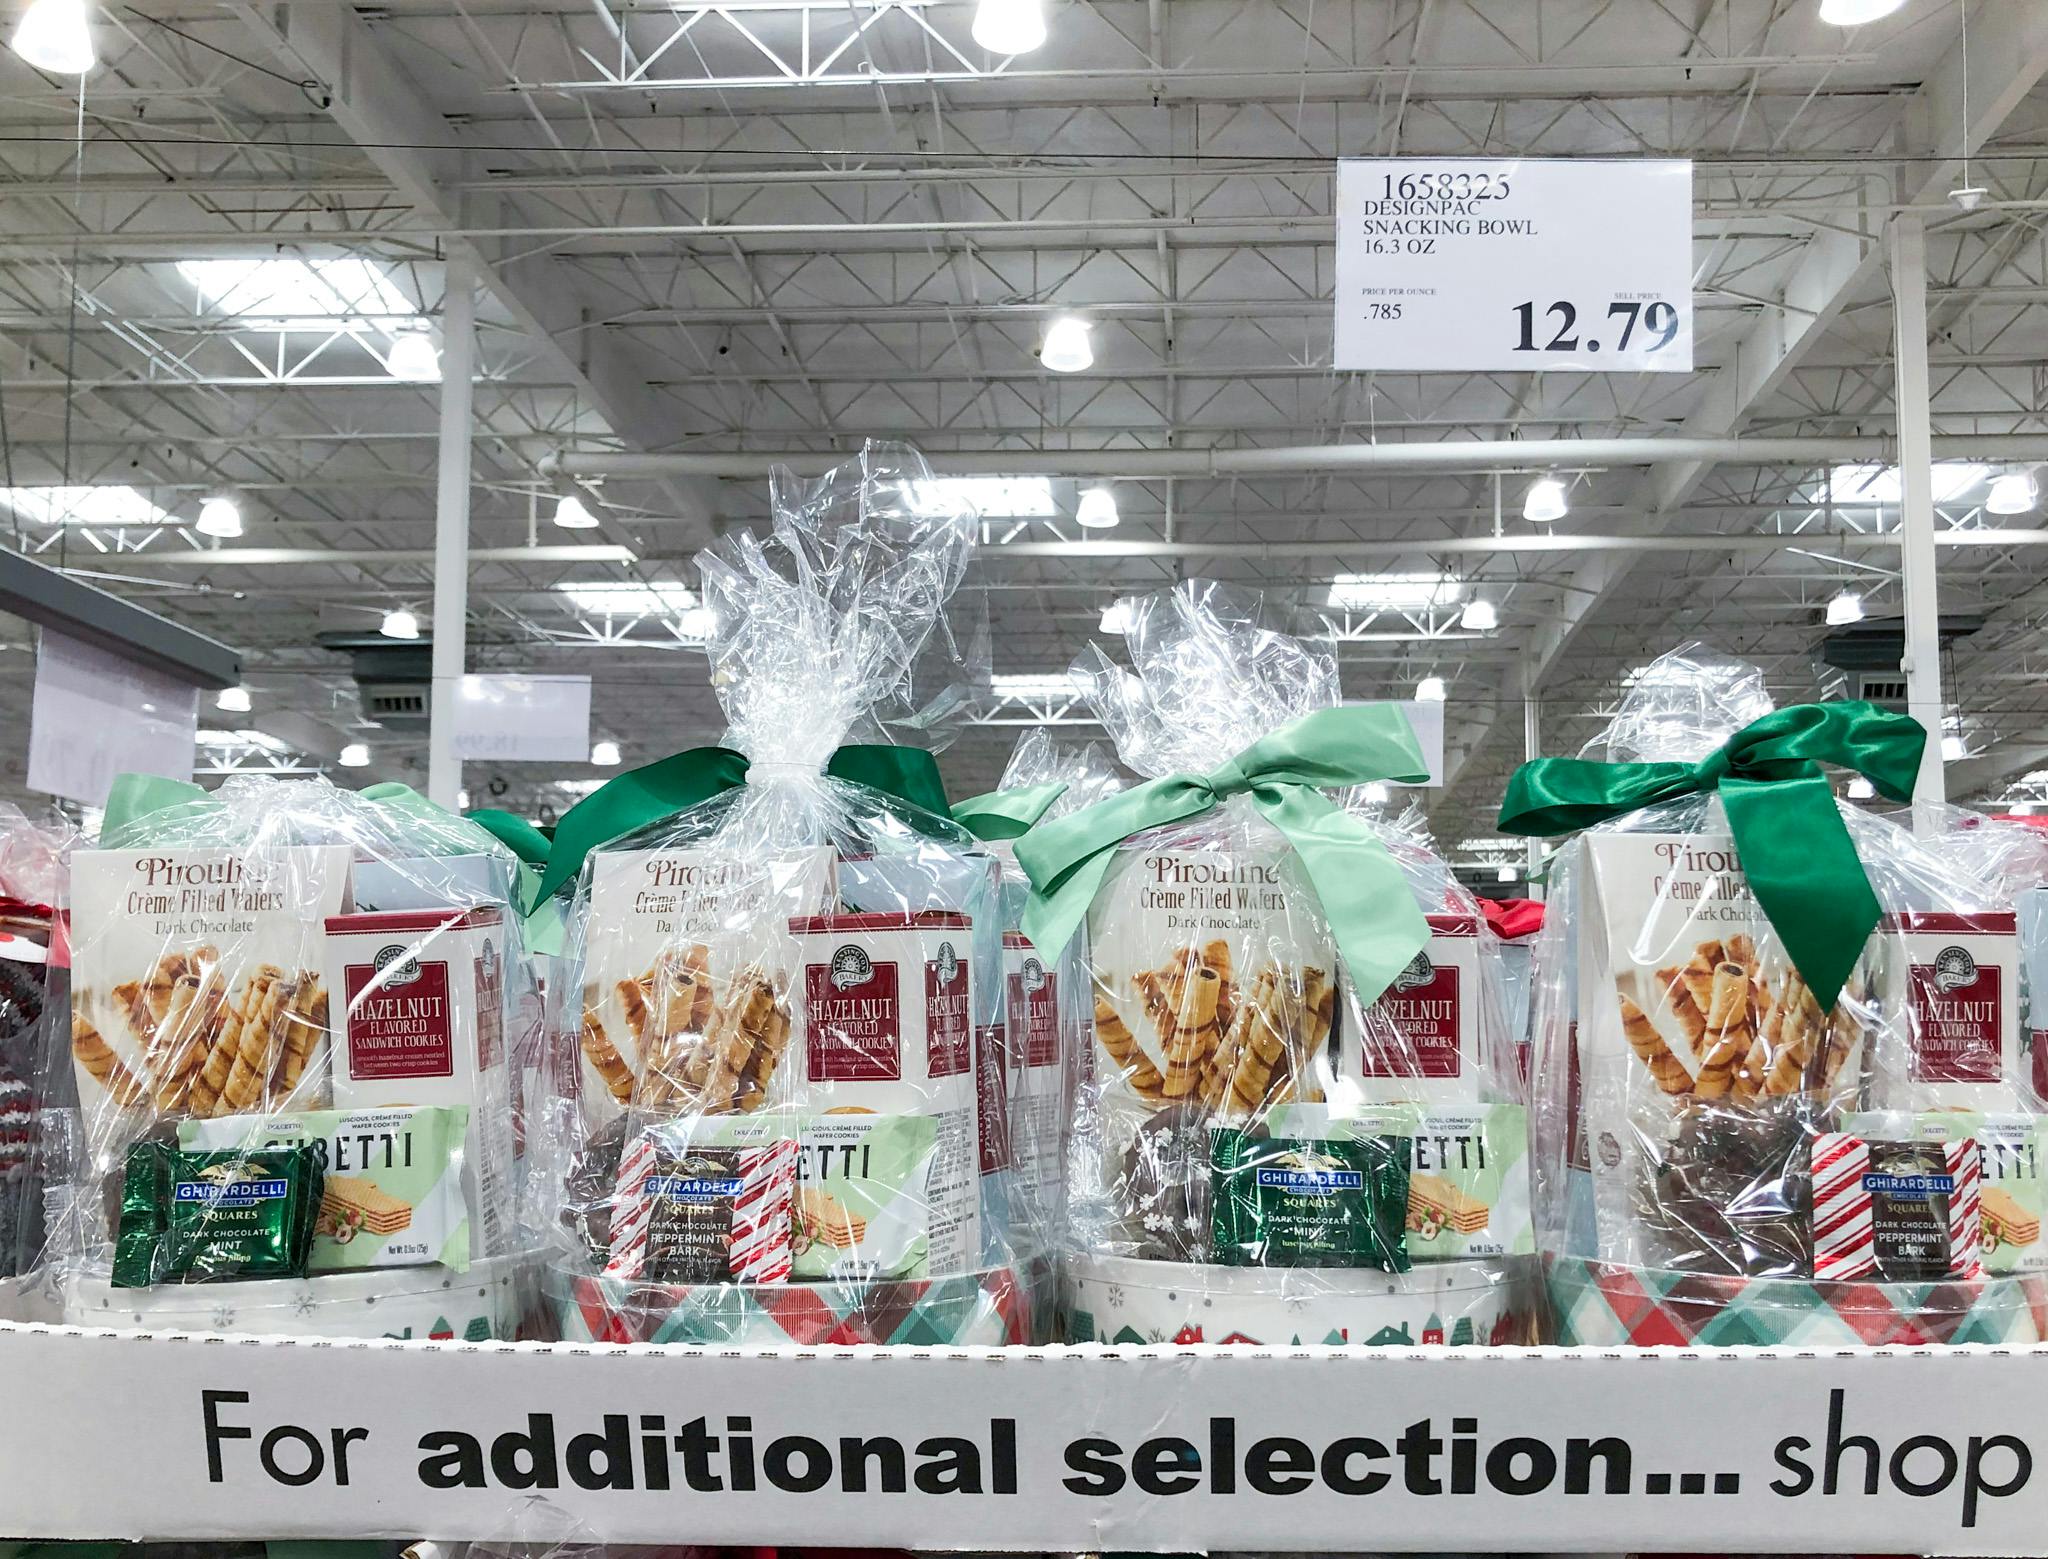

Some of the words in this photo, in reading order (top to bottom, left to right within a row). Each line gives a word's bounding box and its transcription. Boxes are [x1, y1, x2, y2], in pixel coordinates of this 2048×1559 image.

[1382, 173, 1511, 200] 1658325
[1363, 200, 1482, 216] DESIGNPAC
[1363, 219, 1471, 236] SNACKING
[1478, 219, 1538, 236] BOWL
[1363, 238, 1400, 254] 16.3
[1407, 238, 1436, 254] OZ
[1362, 287, 1386, 295] PRICE
[1388, 287, 1405, 295] PER
[1406, 287, 1437, 295] OUNCE
[1614, 292, 1635, 300] SELL
[1637, 292, 1662, 300] PRICE
[1363, 303, 1402, 320] .785
[1511, 300, 1680, 353] 12.79
[1654, 842, 1744, 872] Pirou
[135, 857, 279, 886] Pirouli
[1706, 876, 1750, 901] illed
[1141, 887, 1185, 909] Crème
[1191, 887, 1232, 909] Filled
[155, 920, 186, 935] Dark
[353, 996, 442, 1021] HAZELNUT
[812, 998, 892, 1021] HAZELNUT
[1915, 1001, 1995, 1023] HAZELNUT
[370, 1019, 427, 1035] FLAVORED
[1928, 1023, 1981, 1038] FLAVORED
[355, 1035, 402, 1050] SANDWICH
[404, 1034, 444, 1048] COOKIES
[264, 1132, 412, 1171] BETTI
[1415, 1135, 1486, 1169] ETTI
[796, 1144, 871, 1180] ETTI
[1979, 1143, 2036, 1179] ETTI
[1261, 1172, 1357, 1186] GHIRARDELLI
[1866, 1177, 1952, 1190] GHIRARDELLI
[180, 1183, 285, 1198] GHIRARDELLI
[1283, 1197, 1337, 1209] SQUARES
[1887, 1203, 1929, 1214] SQUARE
[202, 1210, 258, 1221] SQUARES
[1268, 1215, 1293, 1223] DARK
[183, 1230, 209, 1238] DARK
[214, 1229, 270, 1238] CHOCOLATE
[650, 1221, 674, 1229] DARK
[676, 1221, 728, 1231] CHOCOLATE
[1875, 1221, 1899, 1229] DARK
[1901, 1221, 1947, 1230] CHOCOLATE
[210, 1240, 243, 1251] MINT
[651, 1233, 721, 1244] PEPPERMINT
[1879, 1232, 1943, 1244] PEPPERMINT
[669, 1246, 700, 1256] BARK
[1898, 1245, 1926, 1256] BARK
[201, 1389, 369, 1487] For
[416, 1412, 1018, 1495] additional
[1061, 1416, 1740, 1497] selection...
[1769, 1388, 2033, 1528] shop
